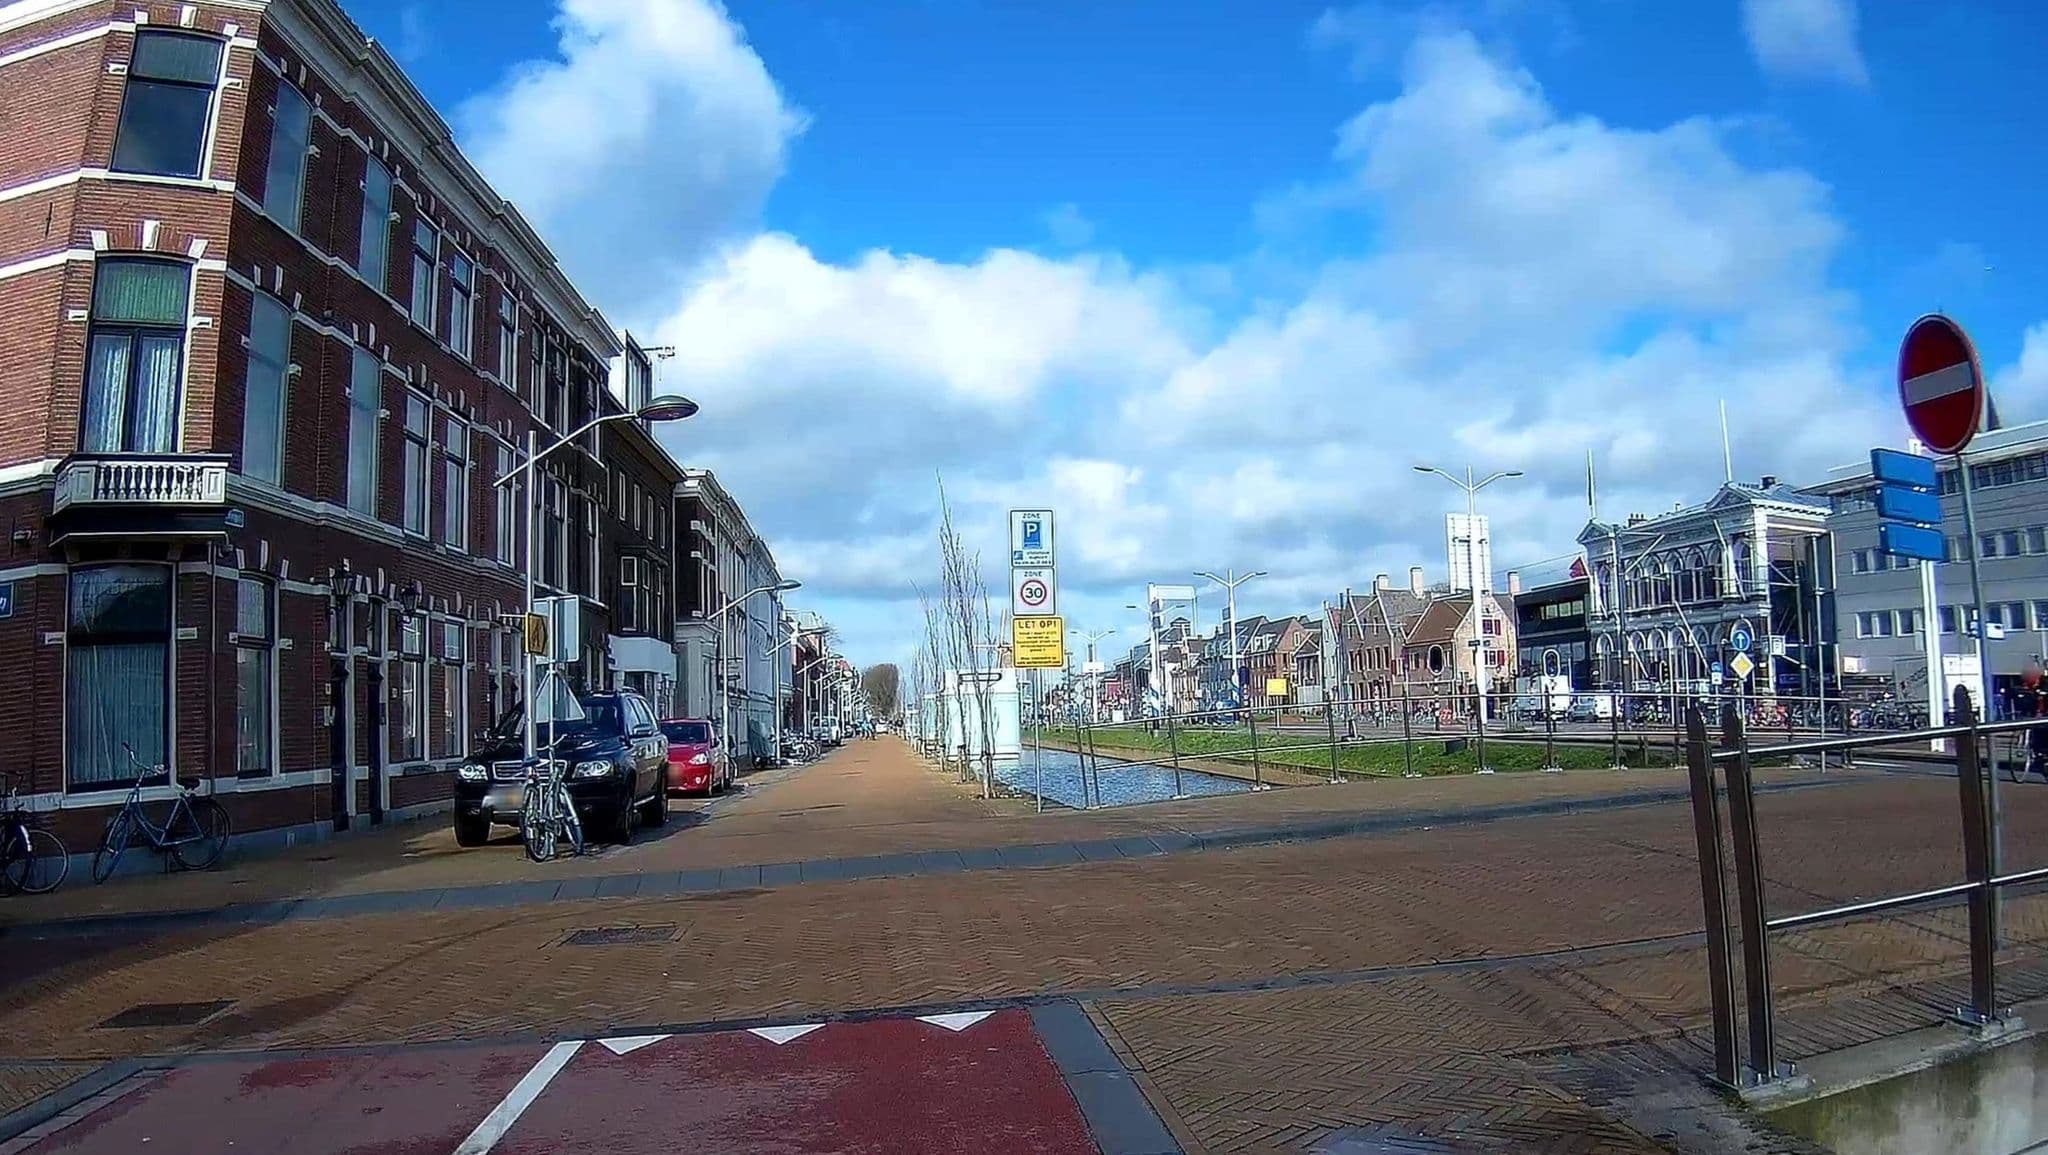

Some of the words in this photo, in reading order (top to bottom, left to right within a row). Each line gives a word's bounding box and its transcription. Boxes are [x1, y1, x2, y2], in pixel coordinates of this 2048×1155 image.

[1026, 523, 1038, 538] P
[1025, 587, 1043, 599] 30
[1018, 621, 1035, 629] LET
[1039, 620, 1056, 628] OP!
